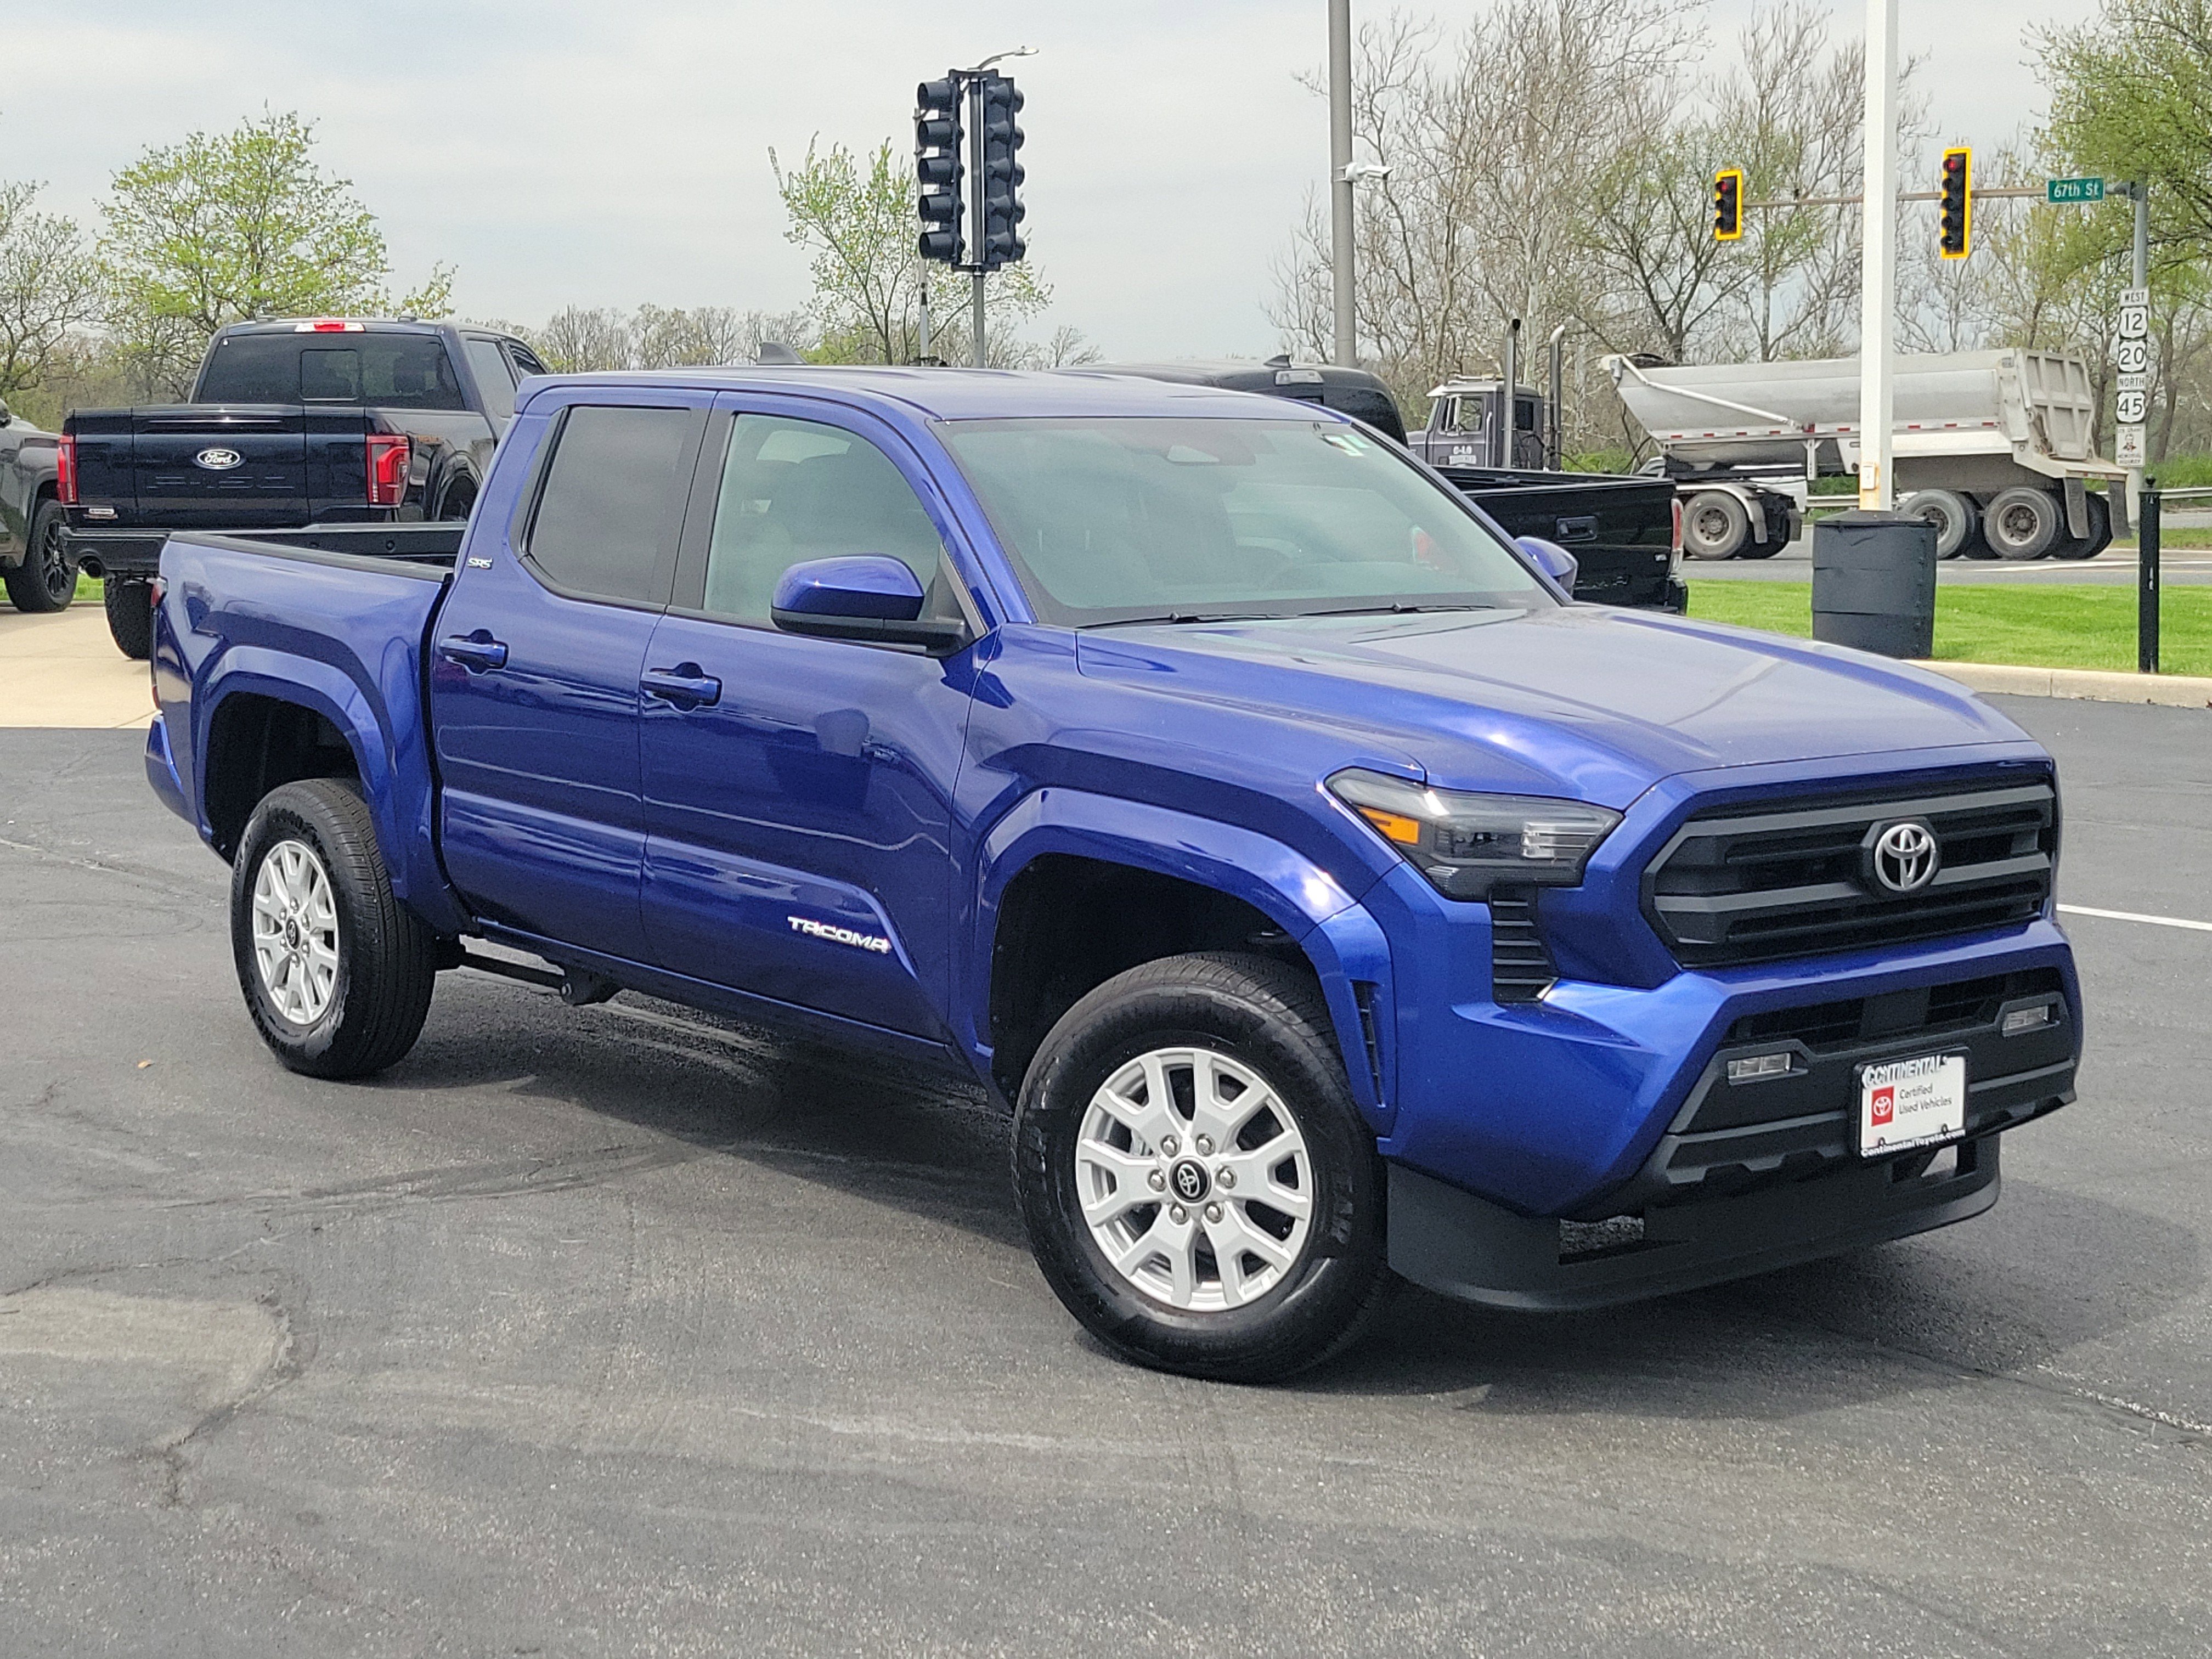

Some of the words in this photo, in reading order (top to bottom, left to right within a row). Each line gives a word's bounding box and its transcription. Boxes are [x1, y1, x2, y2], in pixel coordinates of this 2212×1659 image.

[2054, 183, 2080, 198] 67th
[2085, 182, 2099, 196] St
[2125, 292, 2145, 302] WEST
[2125, 313, 2143, 330] 12
[2120, 347, 2145, 365] 20
[2119, 376, 2145, 387] NORTH
[2118, 398, 2143, 416] 45
[467, 557, 493, 568] SR5
[787, 916, 892, 955] TACOMA
[1863, 1054, 1943, 1086] CONTINENTAL
[1899, 1083, 1933, 1099] Certified
[1899, 1102, 1918, 1115] Used
[1920, 1096, 1952, 1111] Vehicles
